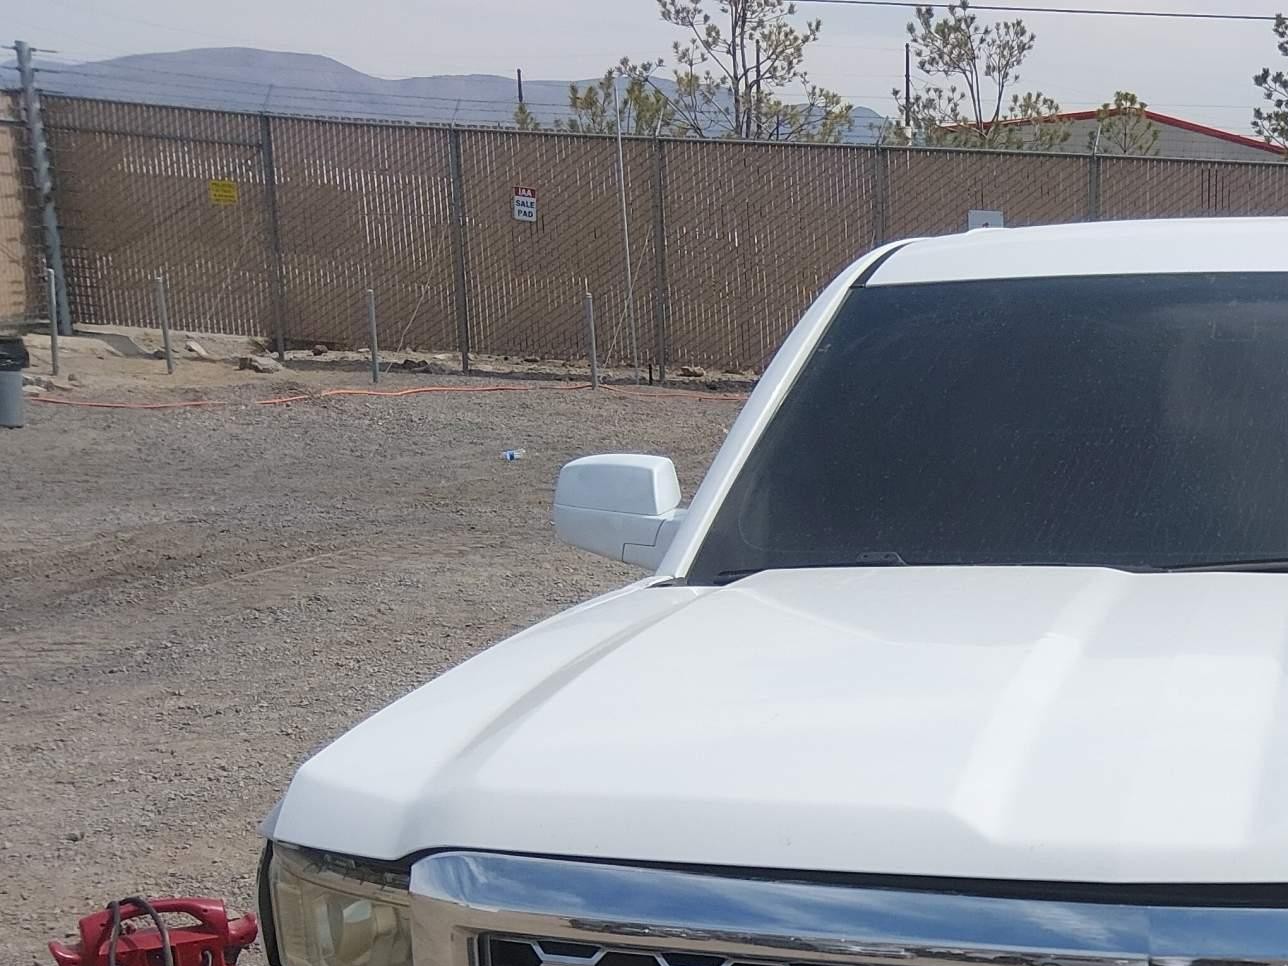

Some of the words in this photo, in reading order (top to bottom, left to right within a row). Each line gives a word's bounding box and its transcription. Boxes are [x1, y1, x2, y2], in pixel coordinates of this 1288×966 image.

[518, 187, 532, 197] IAA
[515, 199, 535, 209] SALE
[517, 209, 534, 218] PAD
